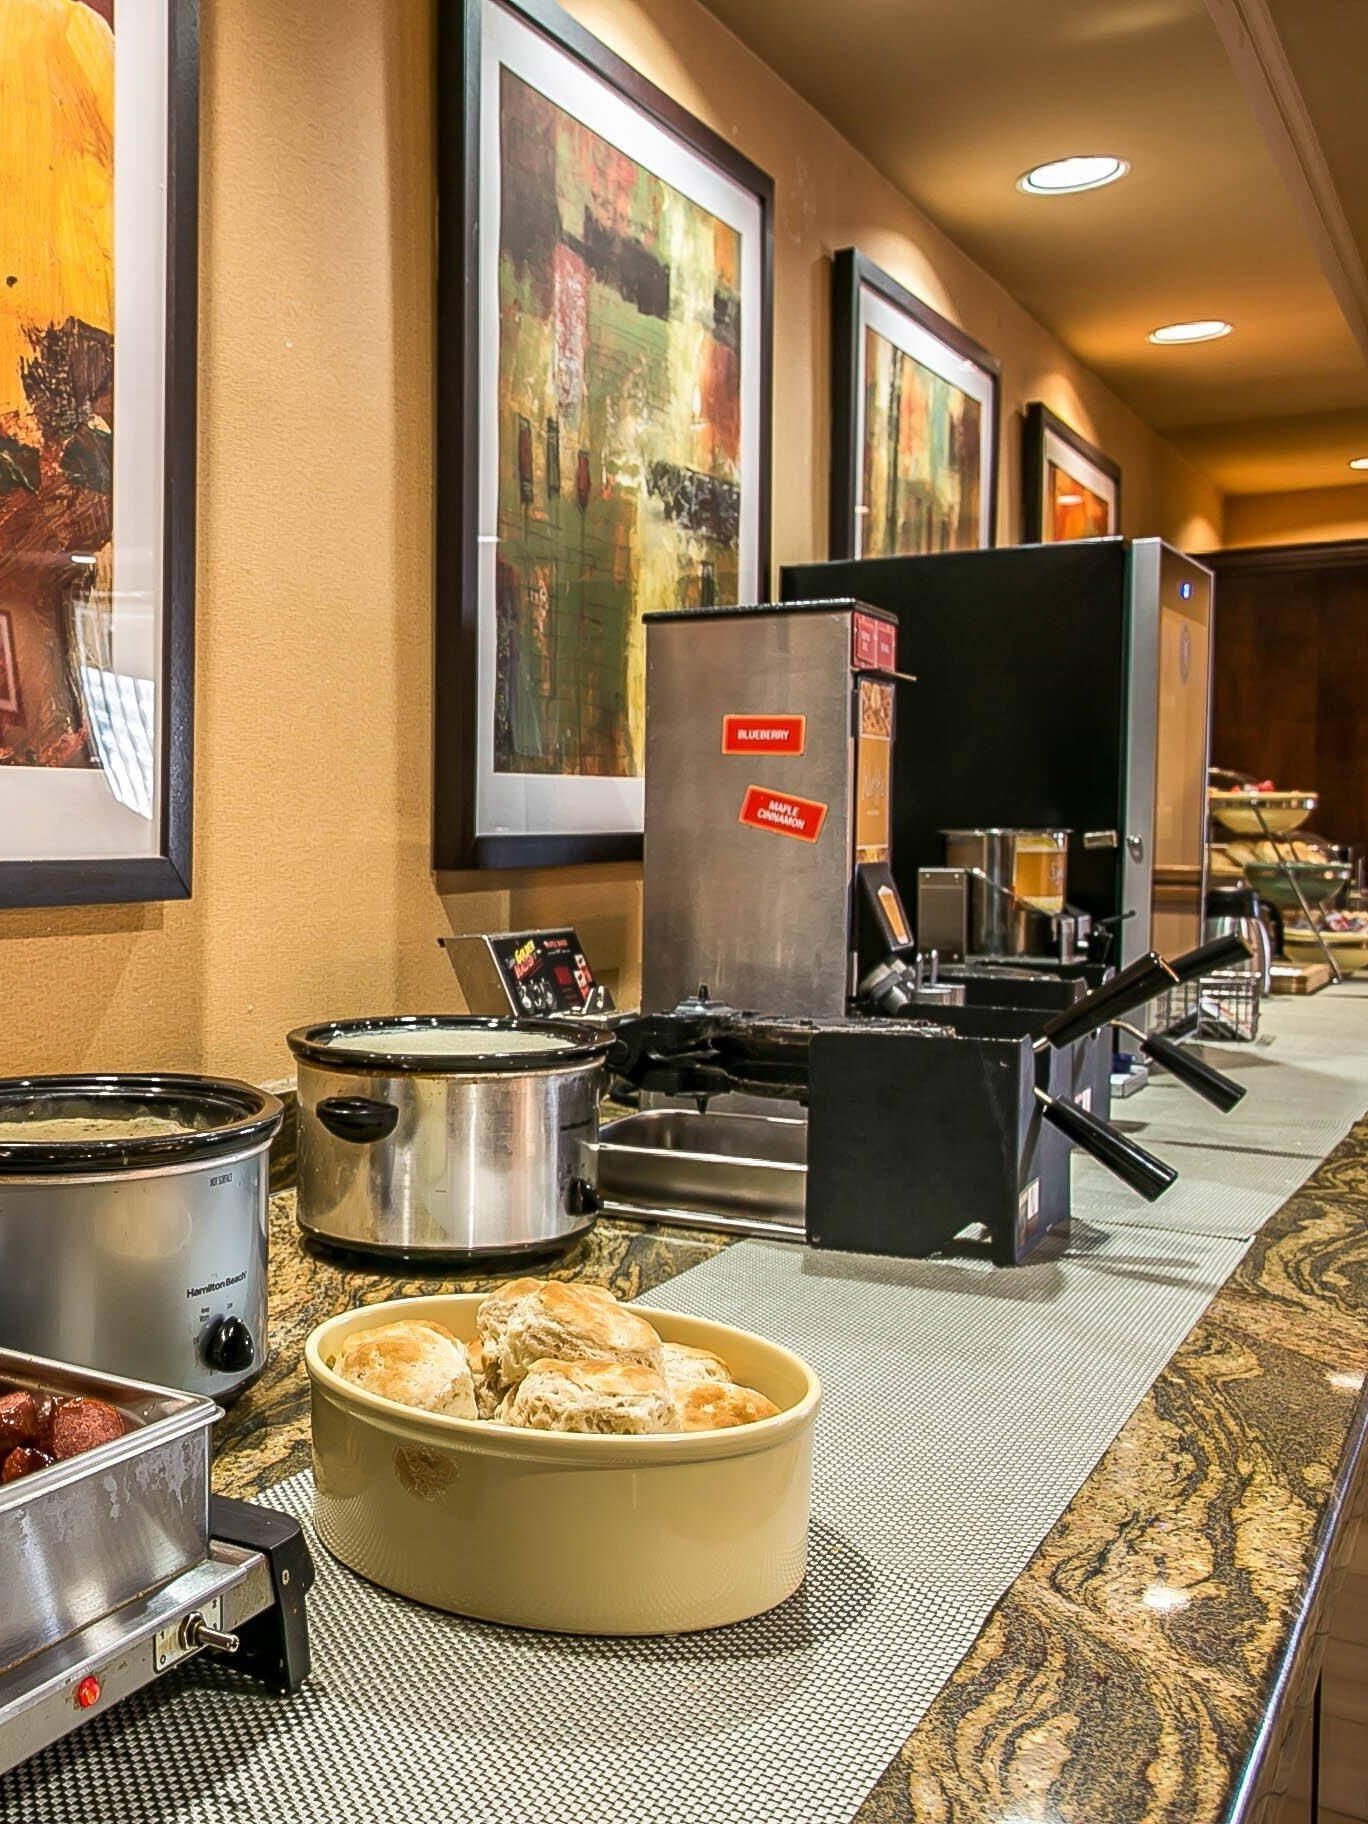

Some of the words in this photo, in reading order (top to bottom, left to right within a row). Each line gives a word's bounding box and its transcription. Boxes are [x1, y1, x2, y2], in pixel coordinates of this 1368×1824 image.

[737, 728, 790, 741] BLUEBERRY
[756, 807, 806, 830] CINNAMON
[768, 799, 801, 818] MAPLE
[186, 1280, 226, 1299] Hamilton
[226, 1270, 247, 1287] Beach
